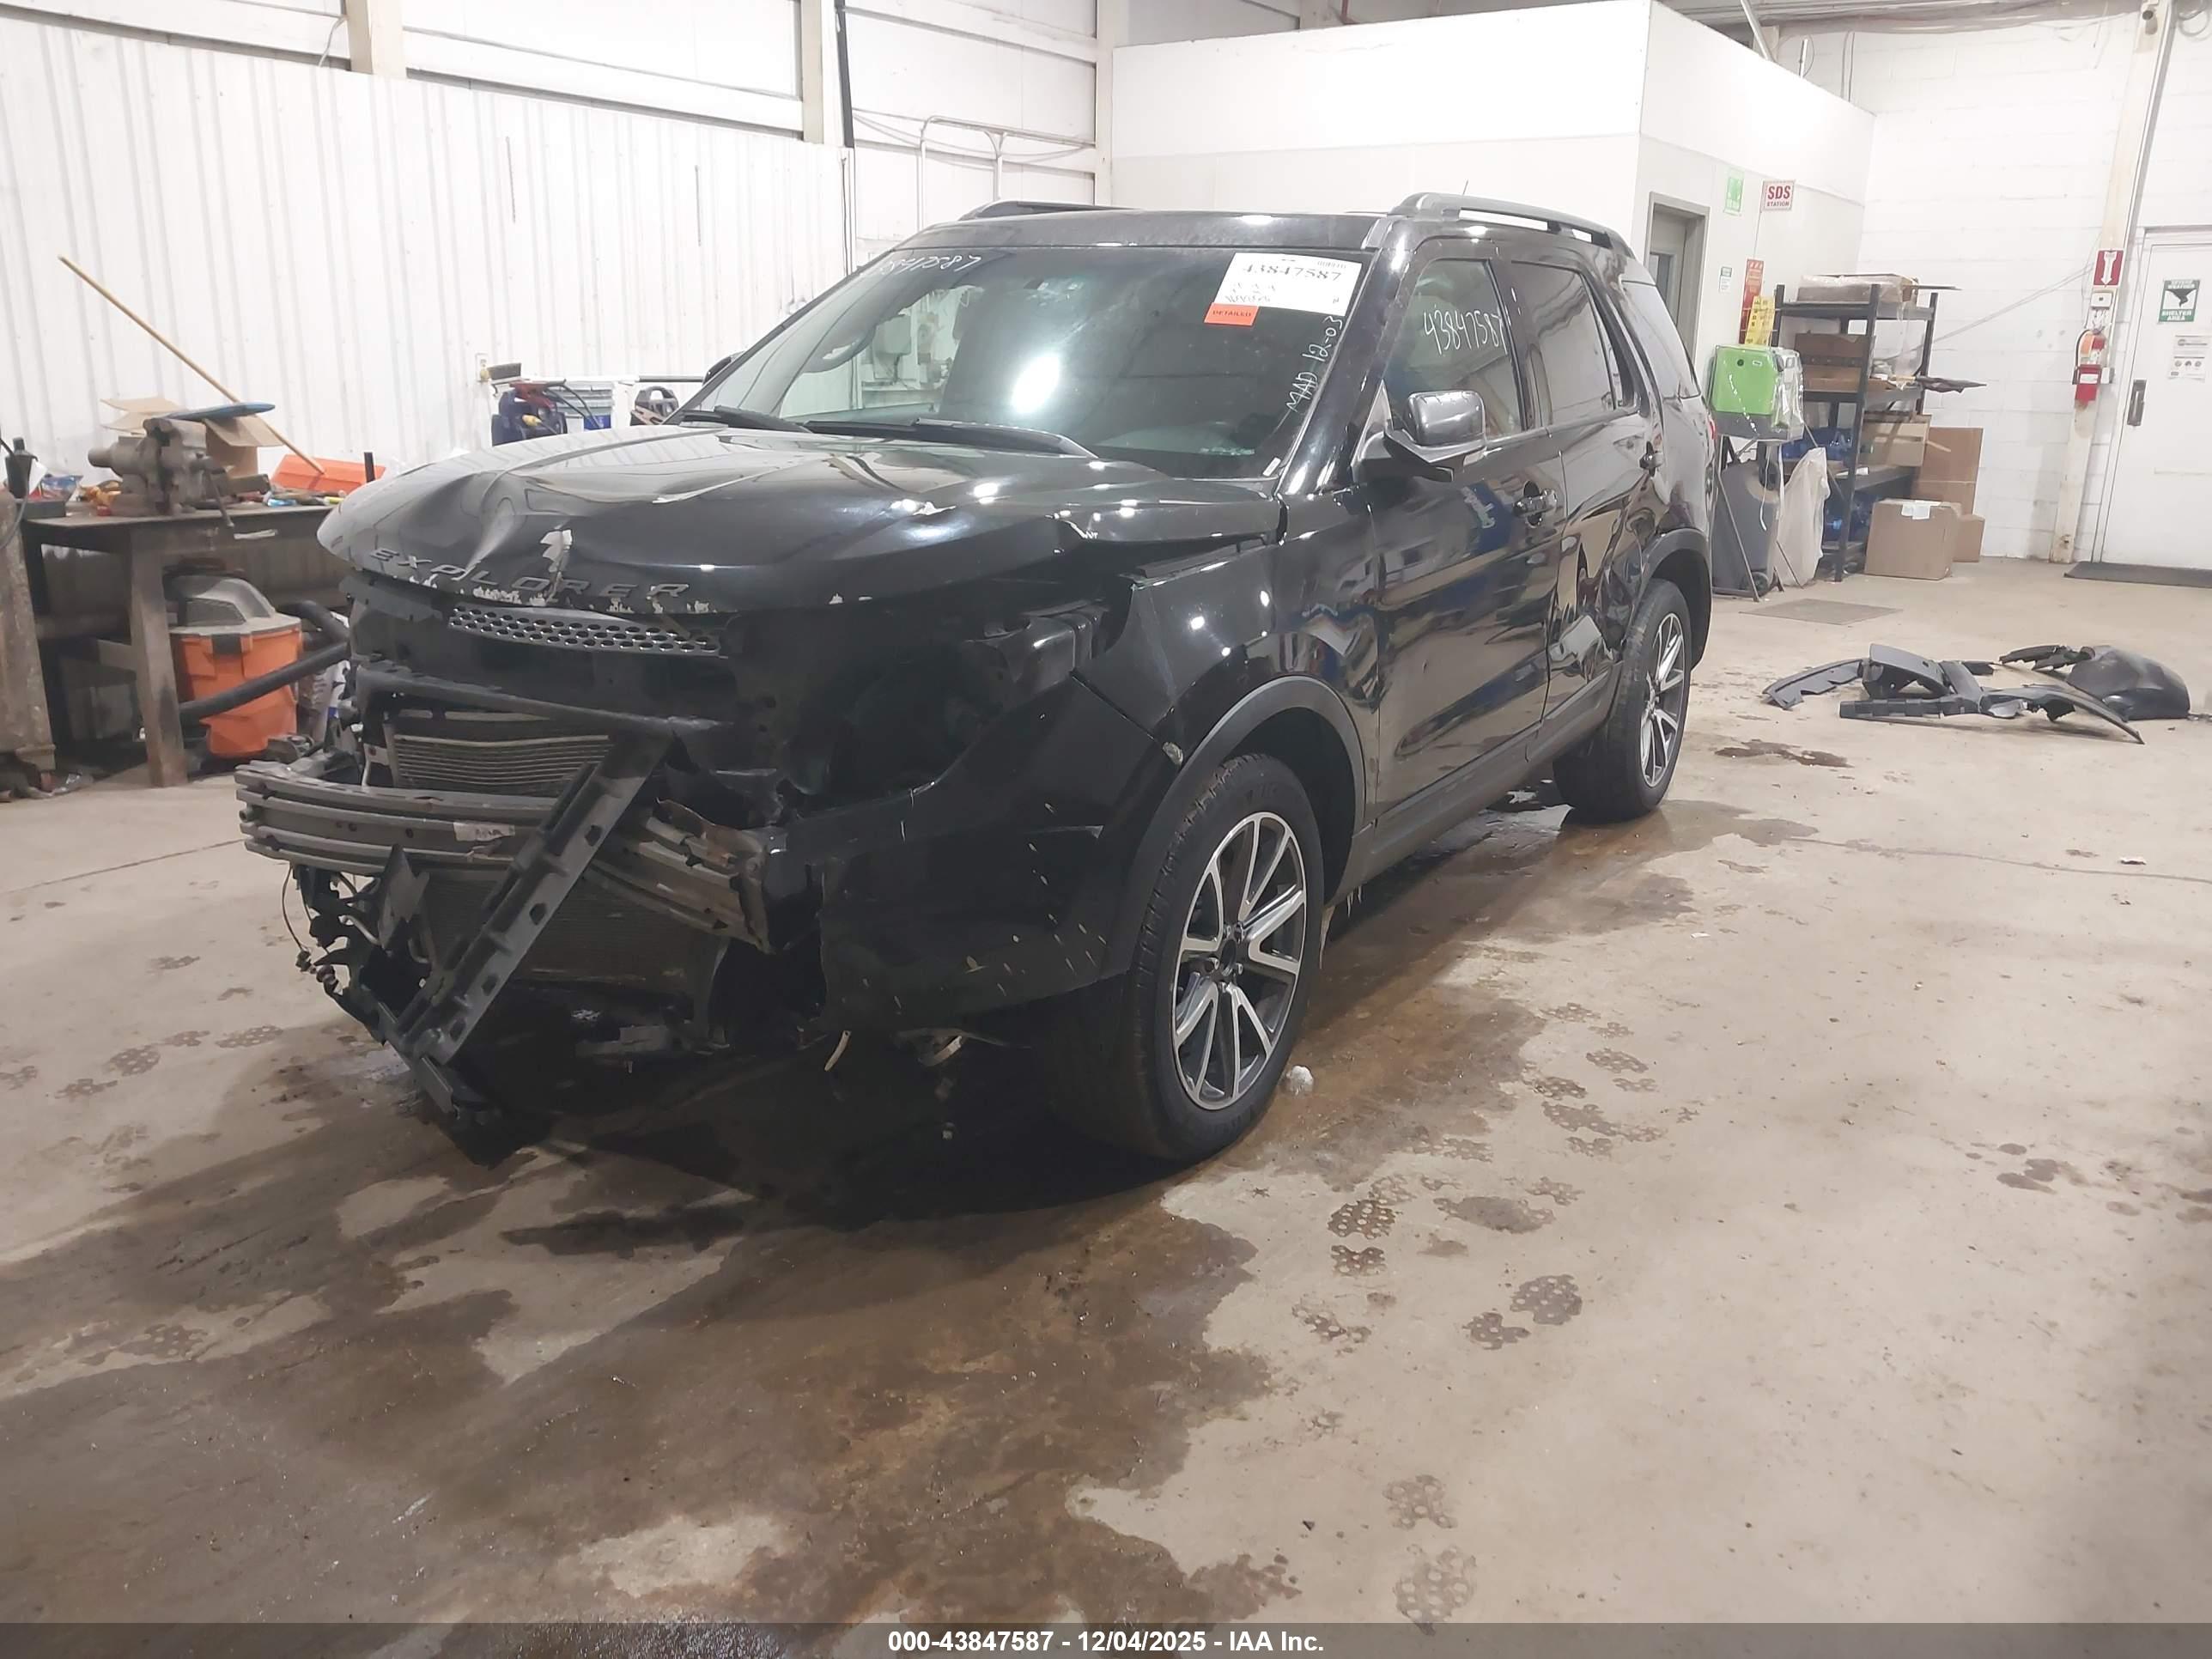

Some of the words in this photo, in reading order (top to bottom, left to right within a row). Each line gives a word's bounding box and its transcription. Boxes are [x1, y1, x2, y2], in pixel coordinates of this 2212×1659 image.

[1767, 185, 1791, 199] SDS
[1212, 308, 1253, 318] DETAILED
[1424, 309, 1508, 356] 43847587
[1286, 371, 1318, 412] MAD
[1302, 315, 1343, 362] 12-03
[369, 548, 690, 599] EXPLORER
